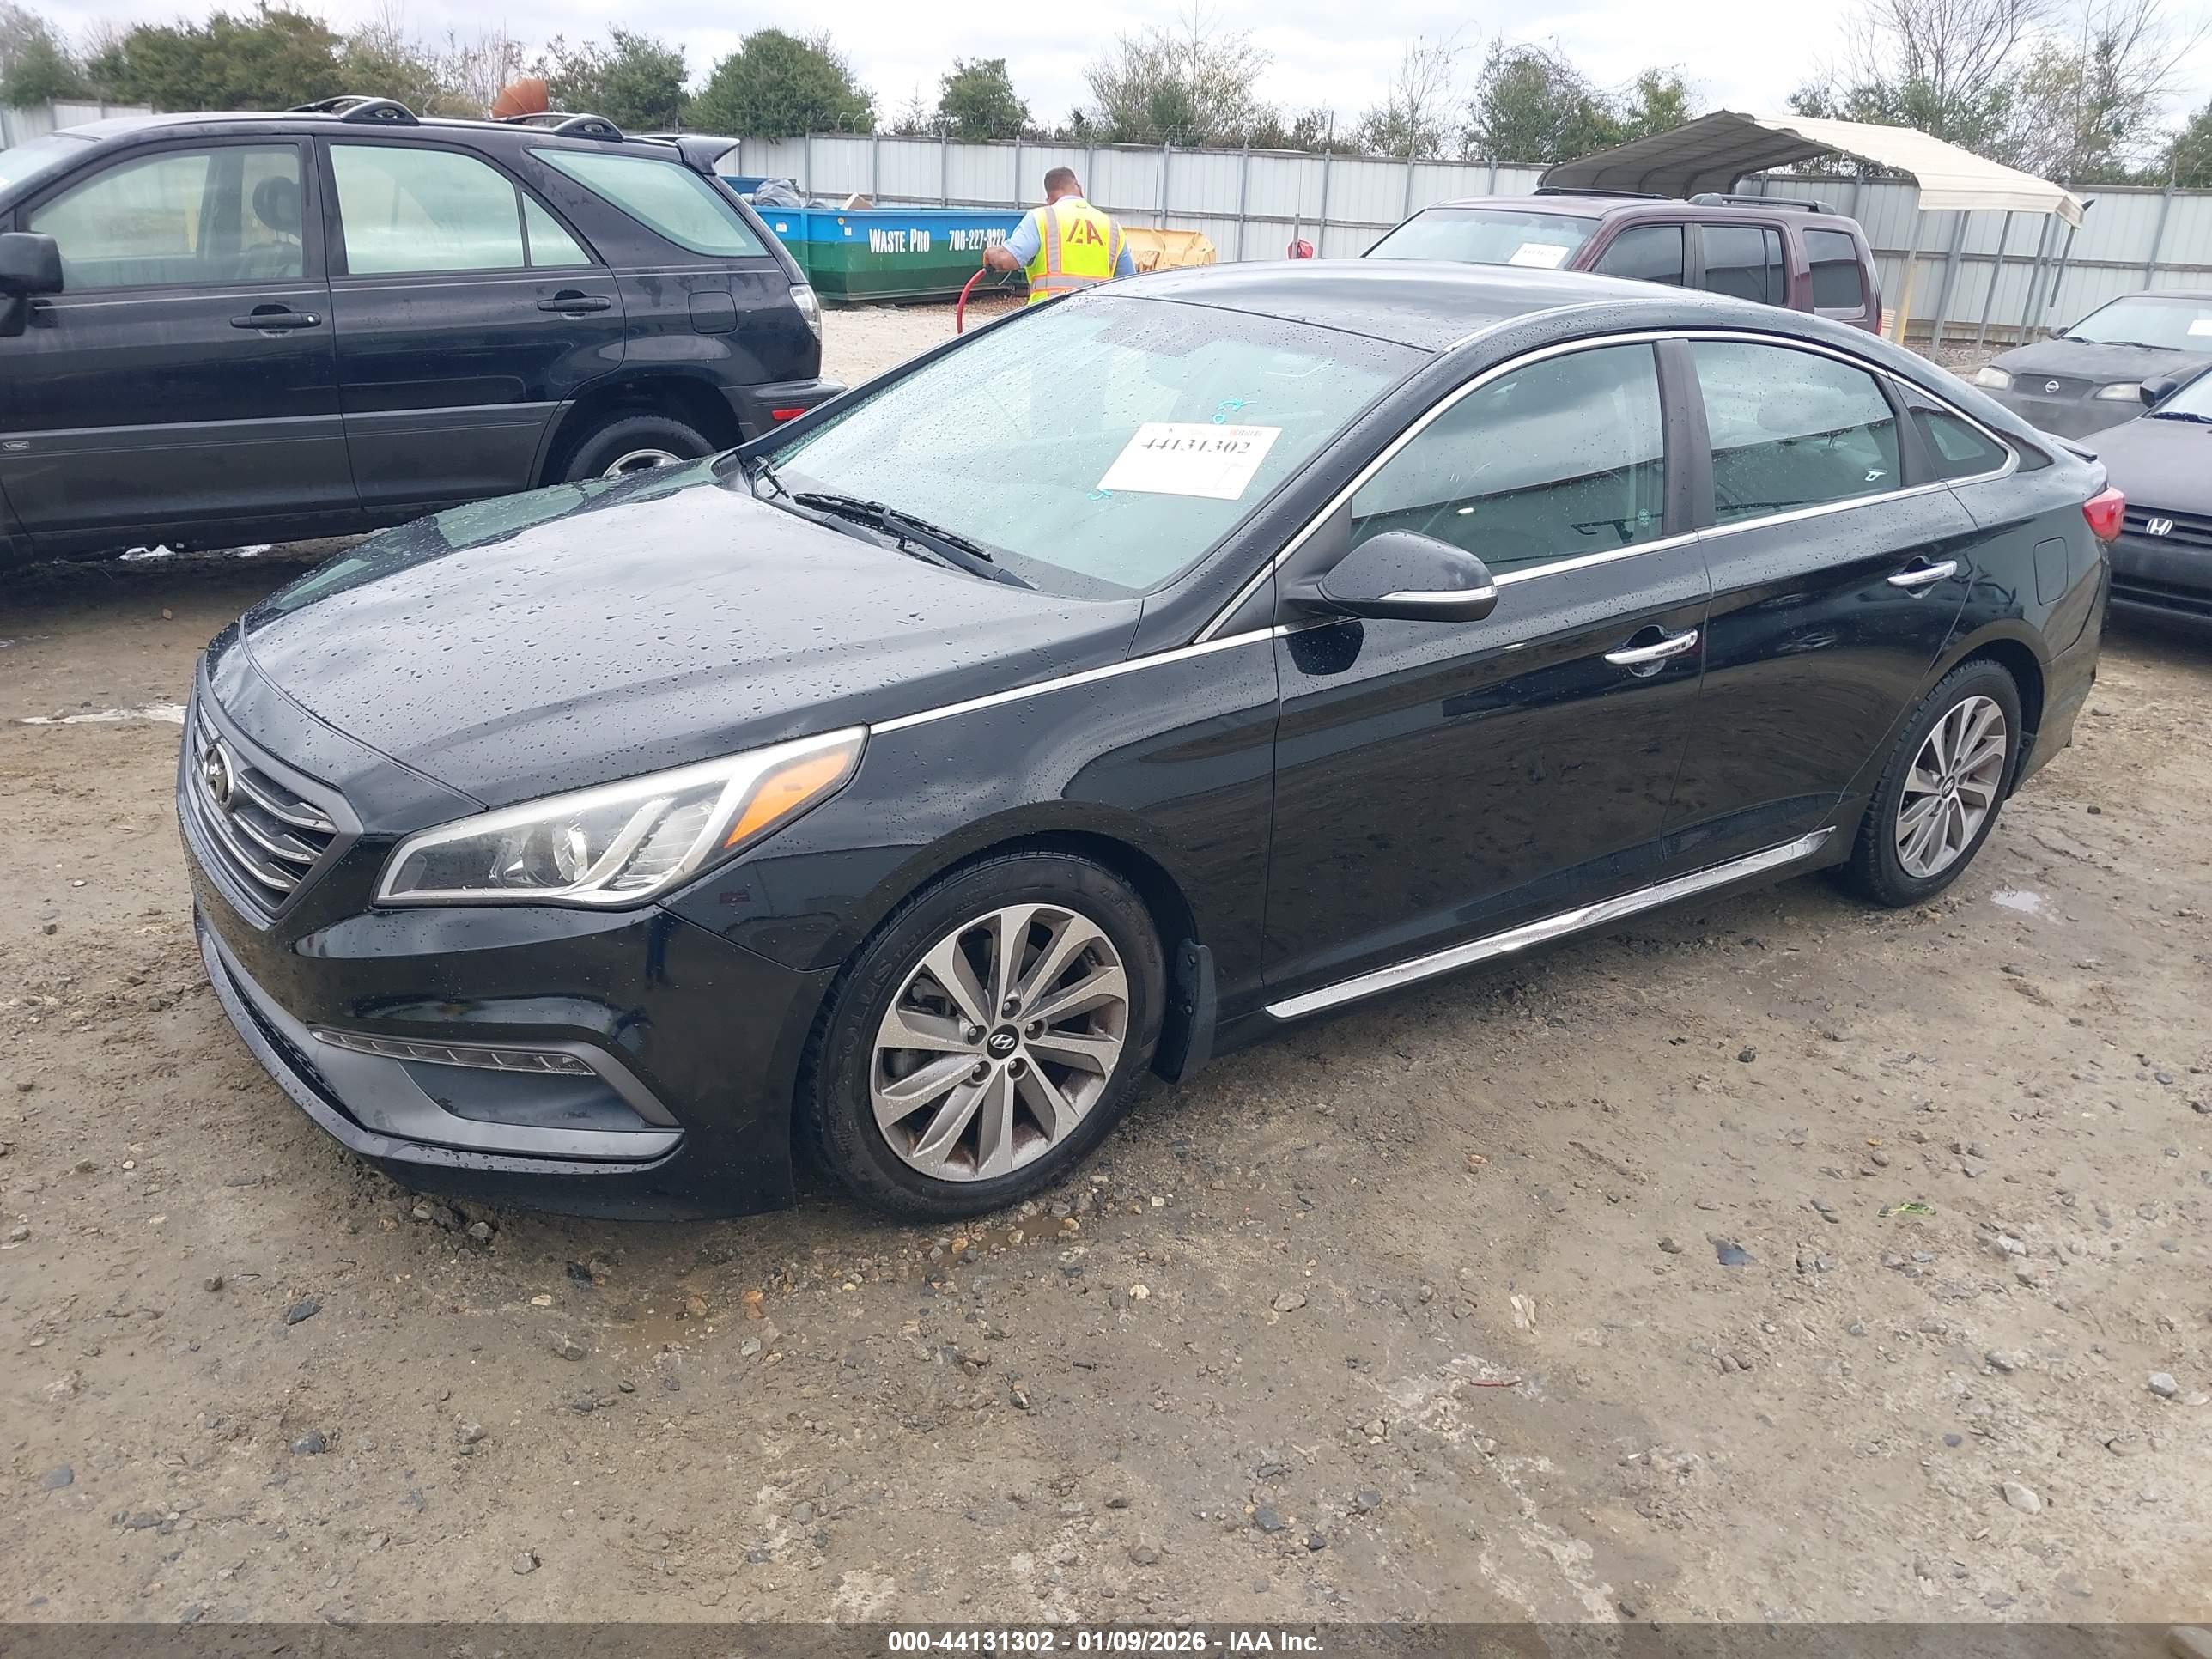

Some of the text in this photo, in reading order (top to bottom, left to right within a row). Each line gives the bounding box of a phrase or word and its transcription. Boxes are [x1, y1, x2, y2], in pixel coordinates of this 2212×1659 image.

[869, 228, 906, 254] WASTE
[910, 228, 930, 252] PRO
[1141, 438, 1251, 454] 44131302
